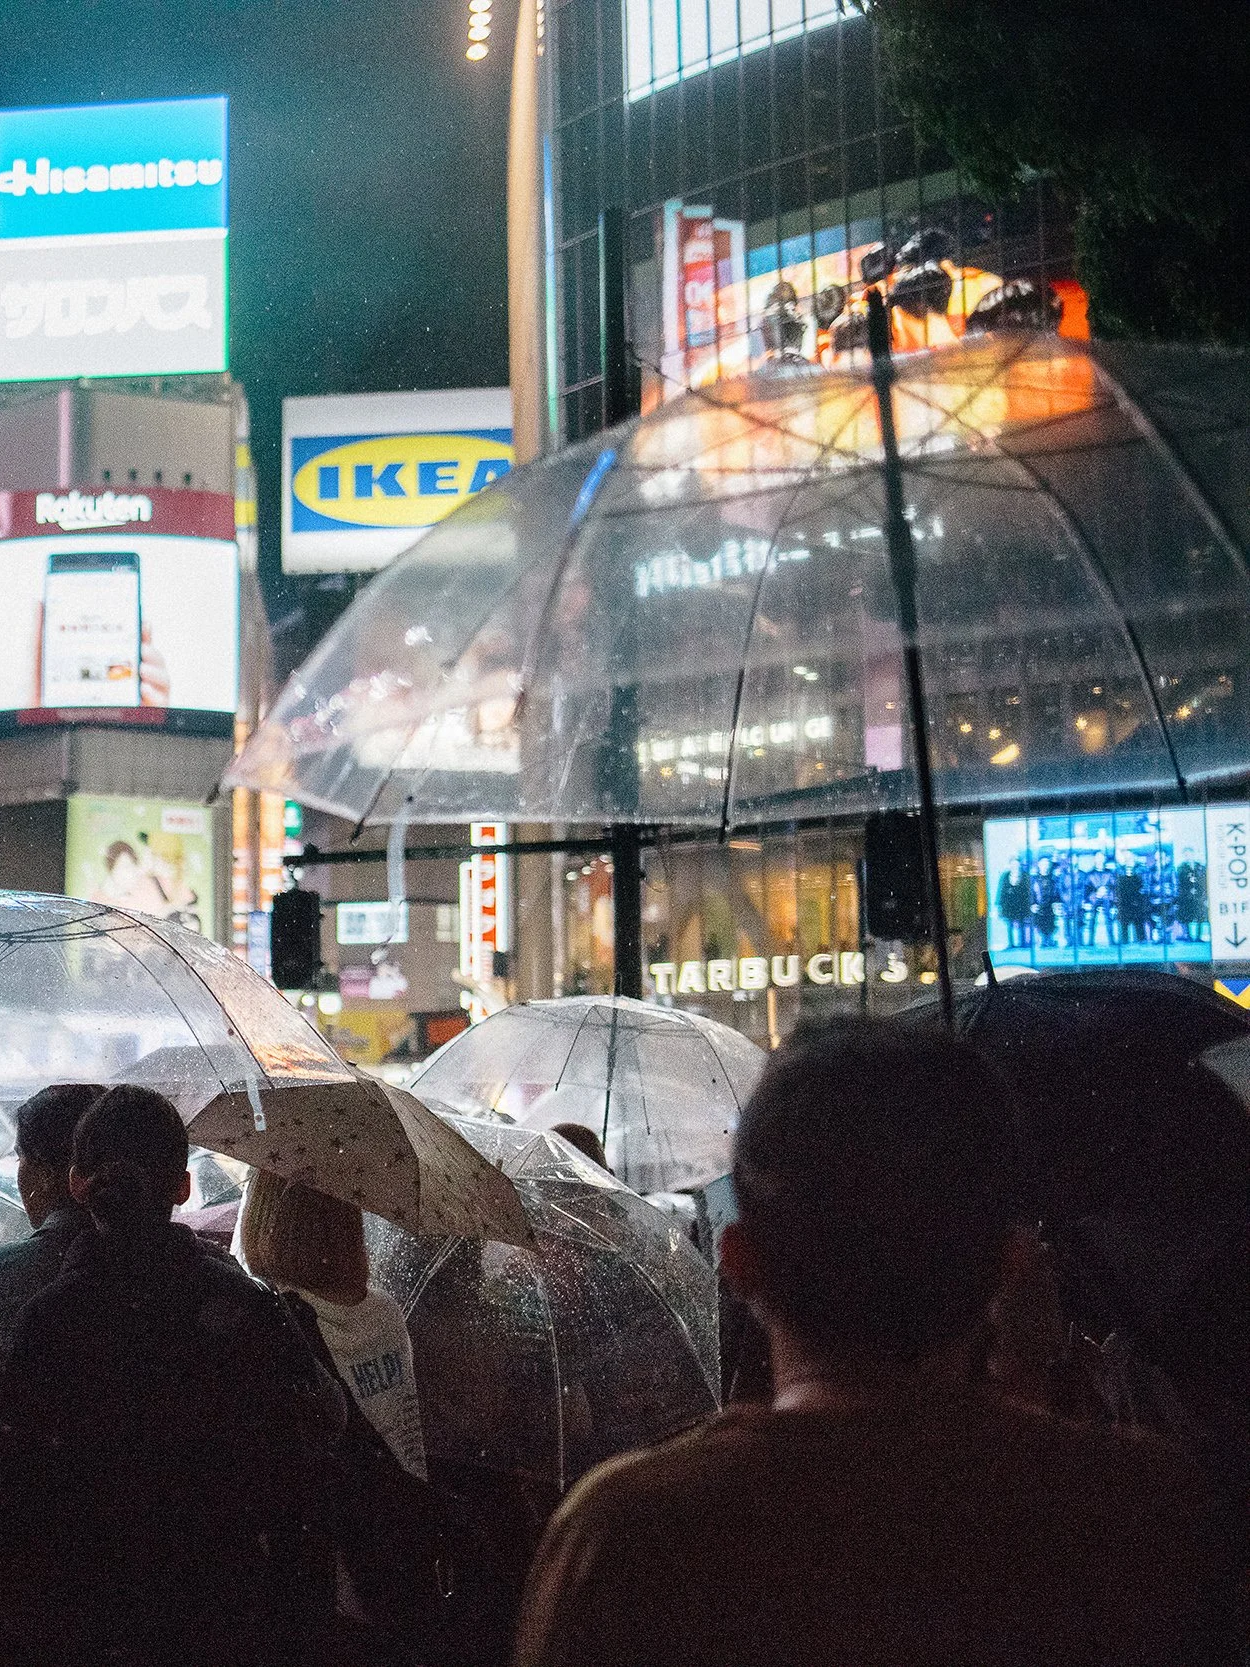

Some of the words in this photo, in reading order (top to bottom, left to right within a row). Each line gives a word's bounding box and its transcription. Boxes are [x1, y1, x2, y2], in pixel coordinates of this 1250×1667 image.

[36, 491, 152, 524] Rakuten
[1226, 822, 1249, 889] K-POP
[650, 951, 909, 994] TARBUCKS
